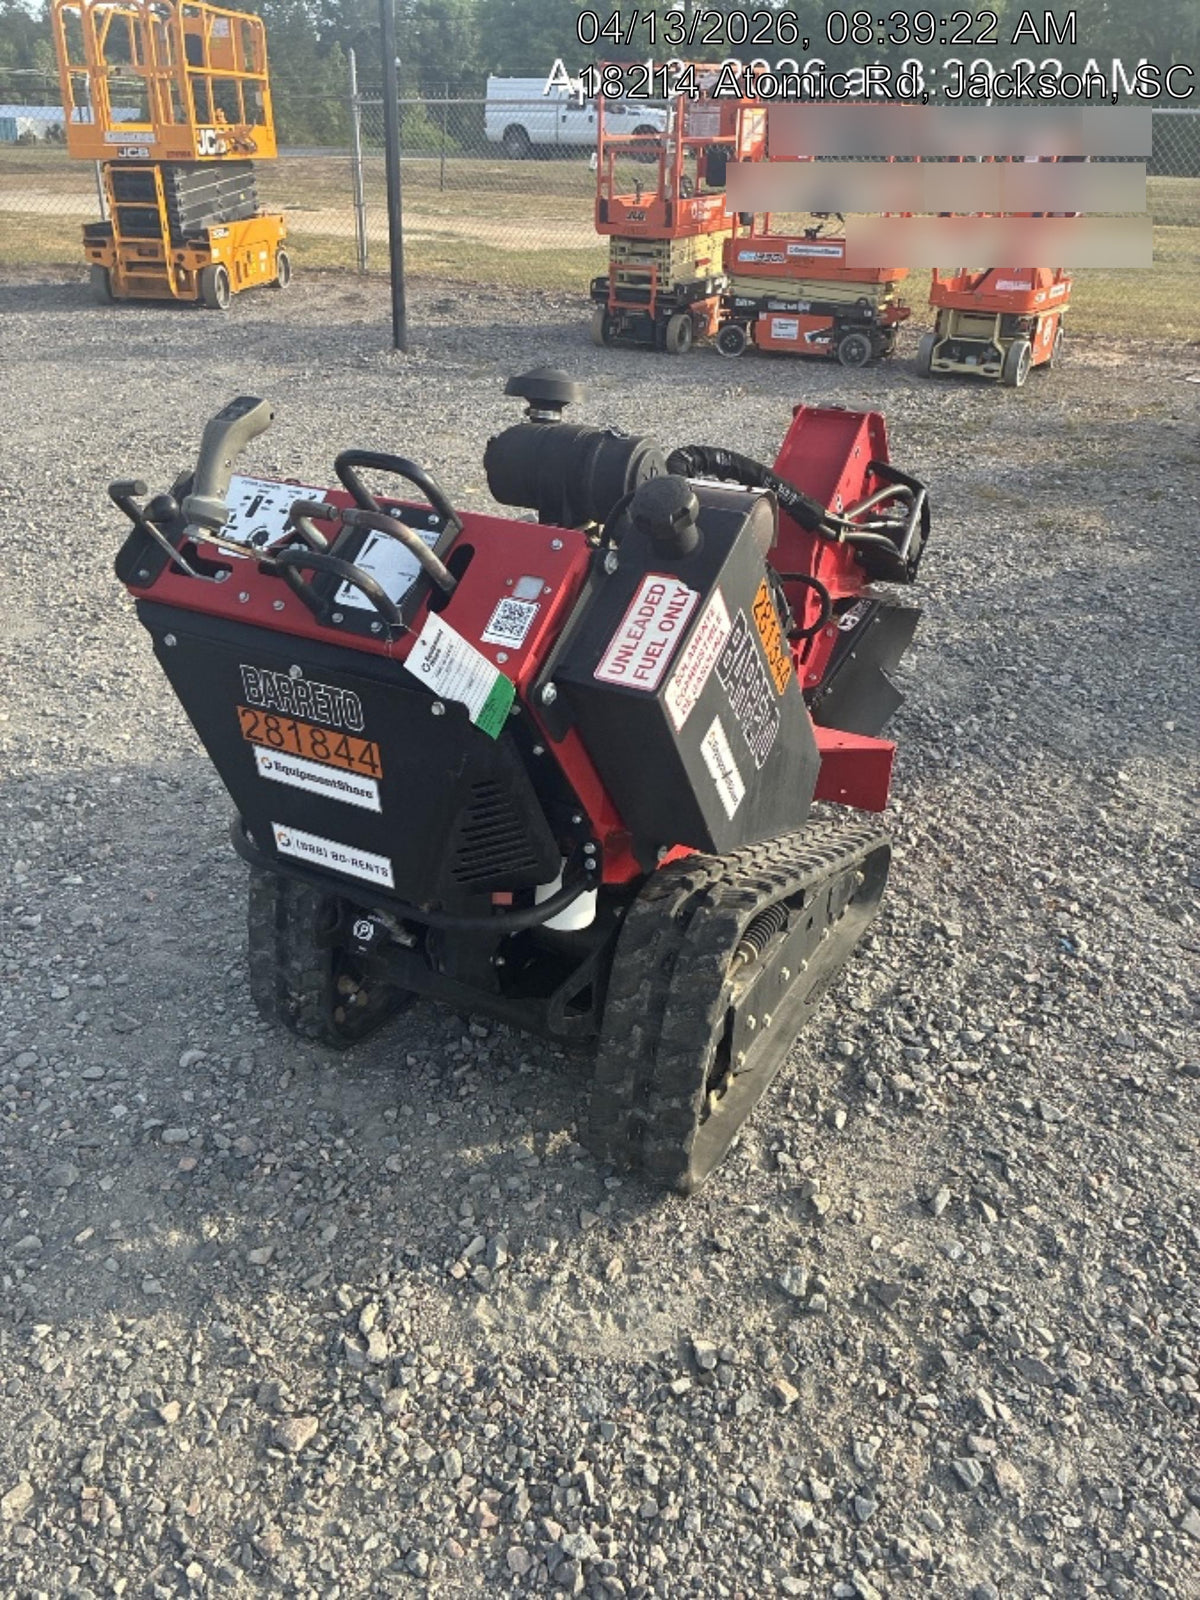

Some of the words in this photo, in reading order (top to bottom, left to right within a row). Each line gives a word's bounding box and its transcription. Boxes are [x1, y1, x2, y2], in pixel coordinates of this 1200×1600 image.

[118, 147, 150, 158] JCB
[608, 584, 666, 675] UNLEADED
[633, 637, 668, 680] FUEL
[658, 586, 691, 632] ONLY
[239, 664, 365, 732] BARRETO
[241, 709, 379, 774] 281844
